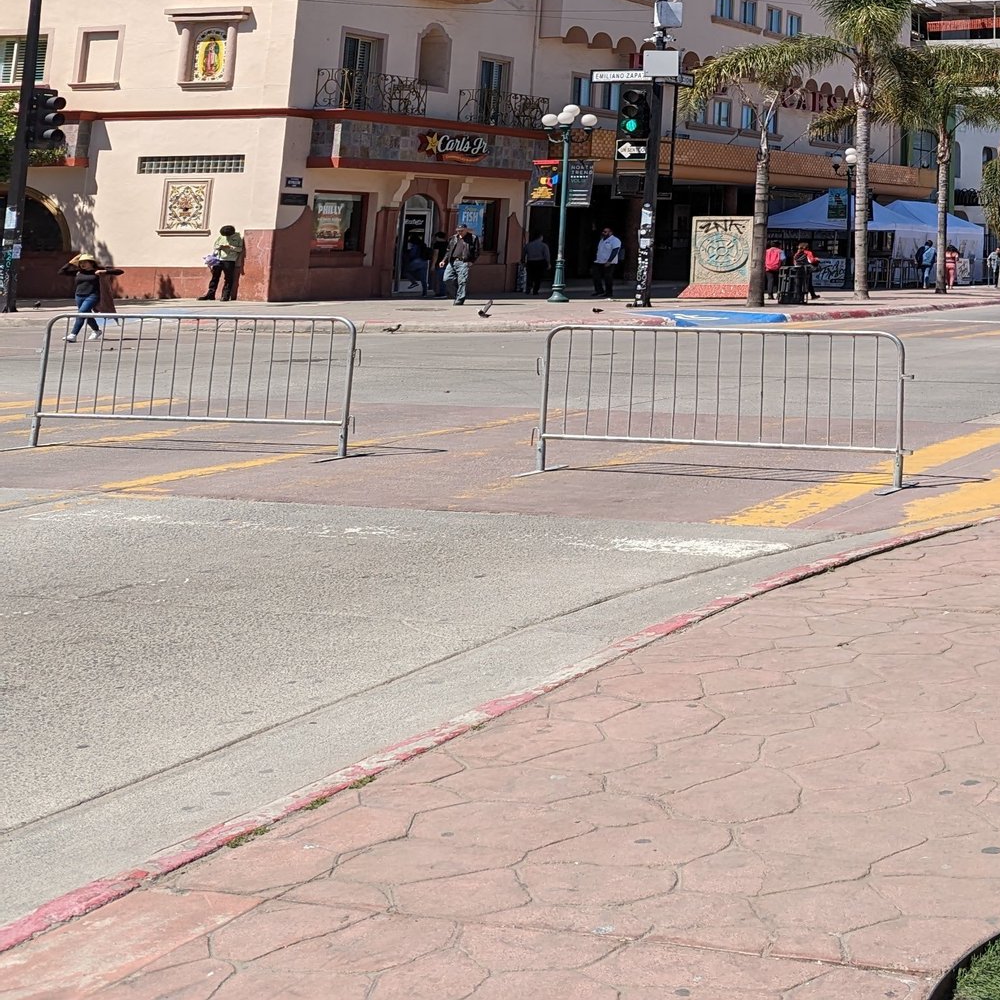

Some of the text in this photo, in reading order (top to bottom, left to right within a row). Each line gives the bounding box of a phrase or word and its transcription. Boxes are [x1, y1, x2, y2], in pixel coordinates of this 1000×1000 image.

[437, 134, 491, 155] Carl's Jr.
[317, 203, 344, 215] PHILLY
[462, 211, 479, 223] FISH
